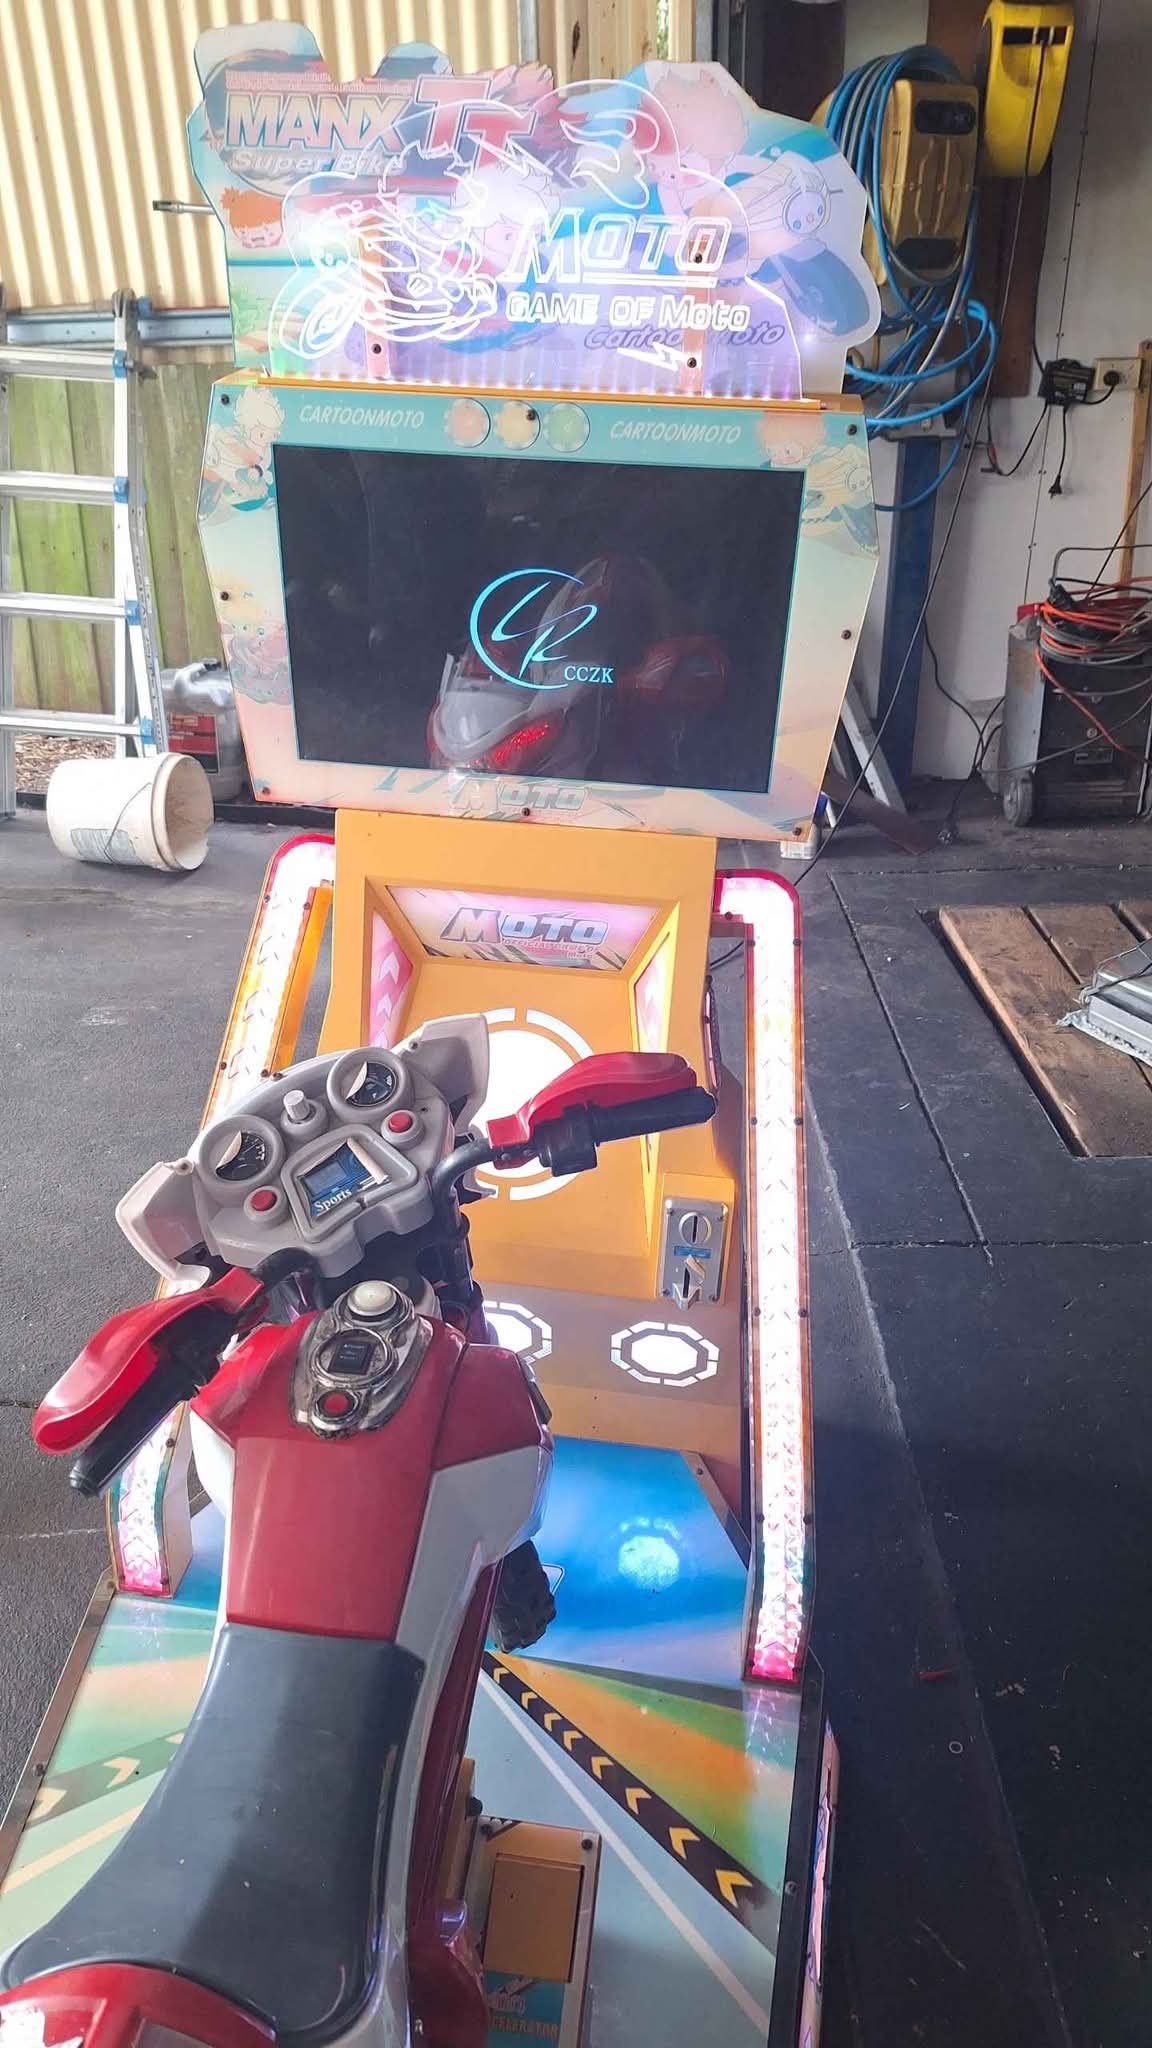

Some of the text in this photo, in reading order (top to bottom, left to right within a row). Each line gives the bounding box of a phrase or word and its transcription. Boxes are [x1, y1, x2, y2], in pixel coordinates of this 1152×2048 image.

[226, 92, 412, 151] MANX
[229, 150, 335, 175] Super
[505, 291, 751, 332] GAME OF Moto
[299, 404, 425, 429] CARTOONMOTO
[609, 420, 742, 445] CARTOONMOTO
[564, 665, 614, 684] CCZK
[314, 1188, 352, 1212] Sports
